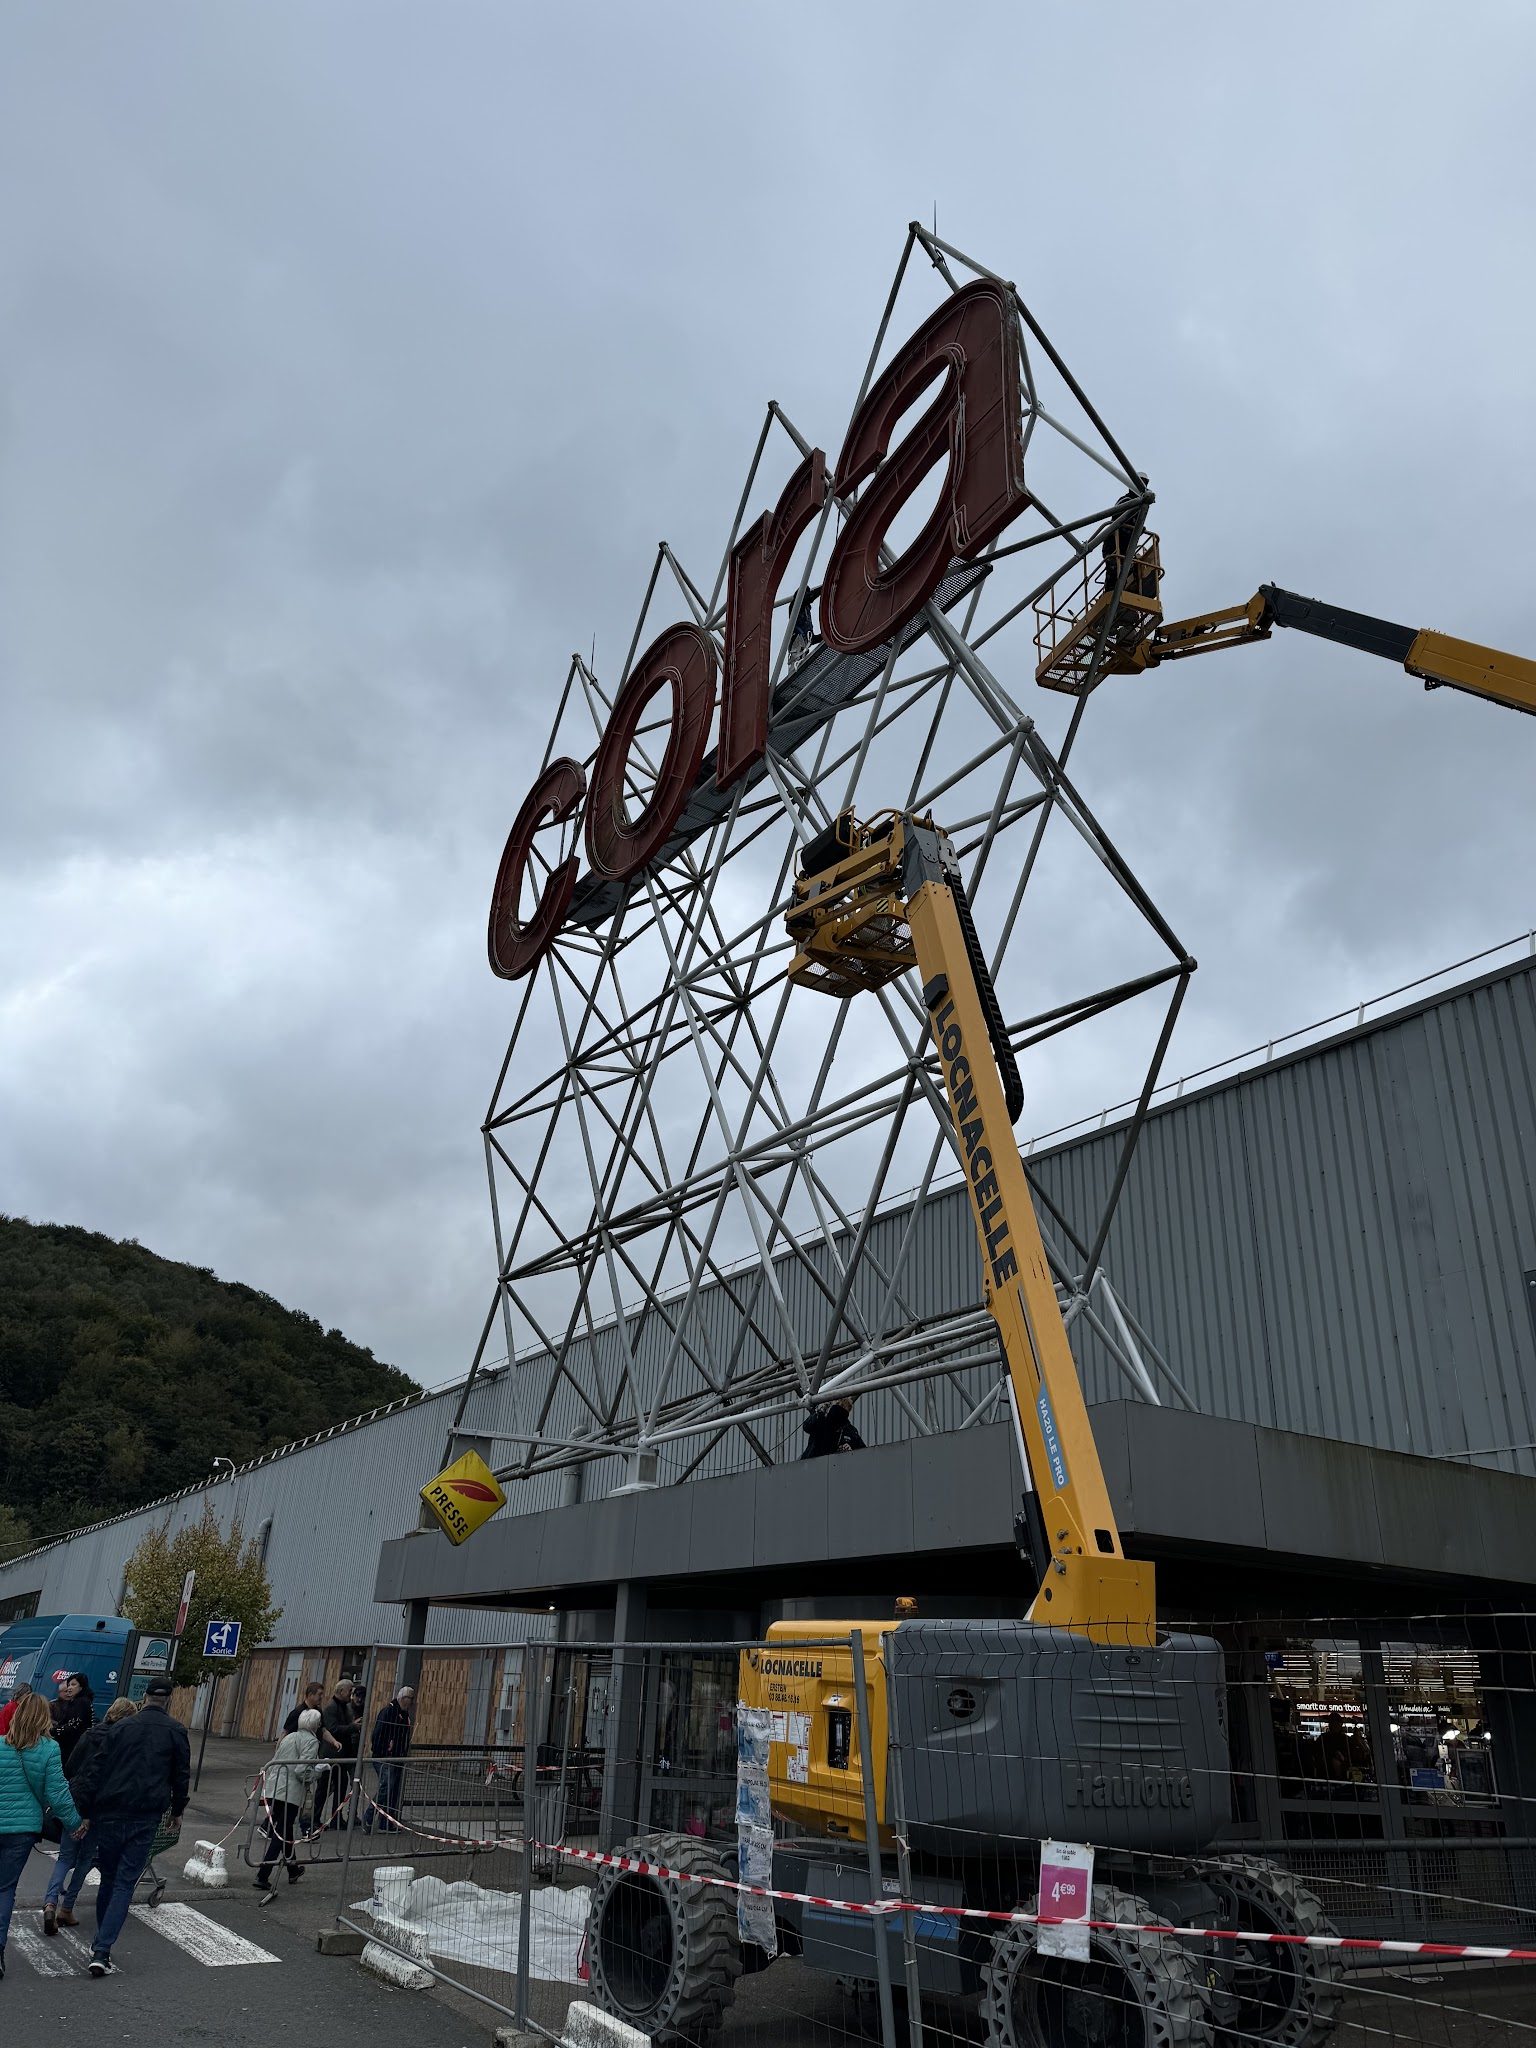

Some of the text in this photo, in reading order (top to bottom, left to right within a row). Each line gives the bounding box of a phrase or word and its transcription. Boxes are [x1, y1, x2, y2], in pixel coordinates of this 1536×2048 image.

[488, 278, 1032, 981] cora
[935, 999, 1019, 1290] LOCNACELLE
[1040, 1398, 1065, 1485] HA20 LE PRO
[430, 1486, 469, 1537] PRESSE
[211, 1646, 232, 1655] Sortie
[760, 1659, 823, 1678] LOCNACELLE
[1066, 1764, 1193, 1807] Haulotte
